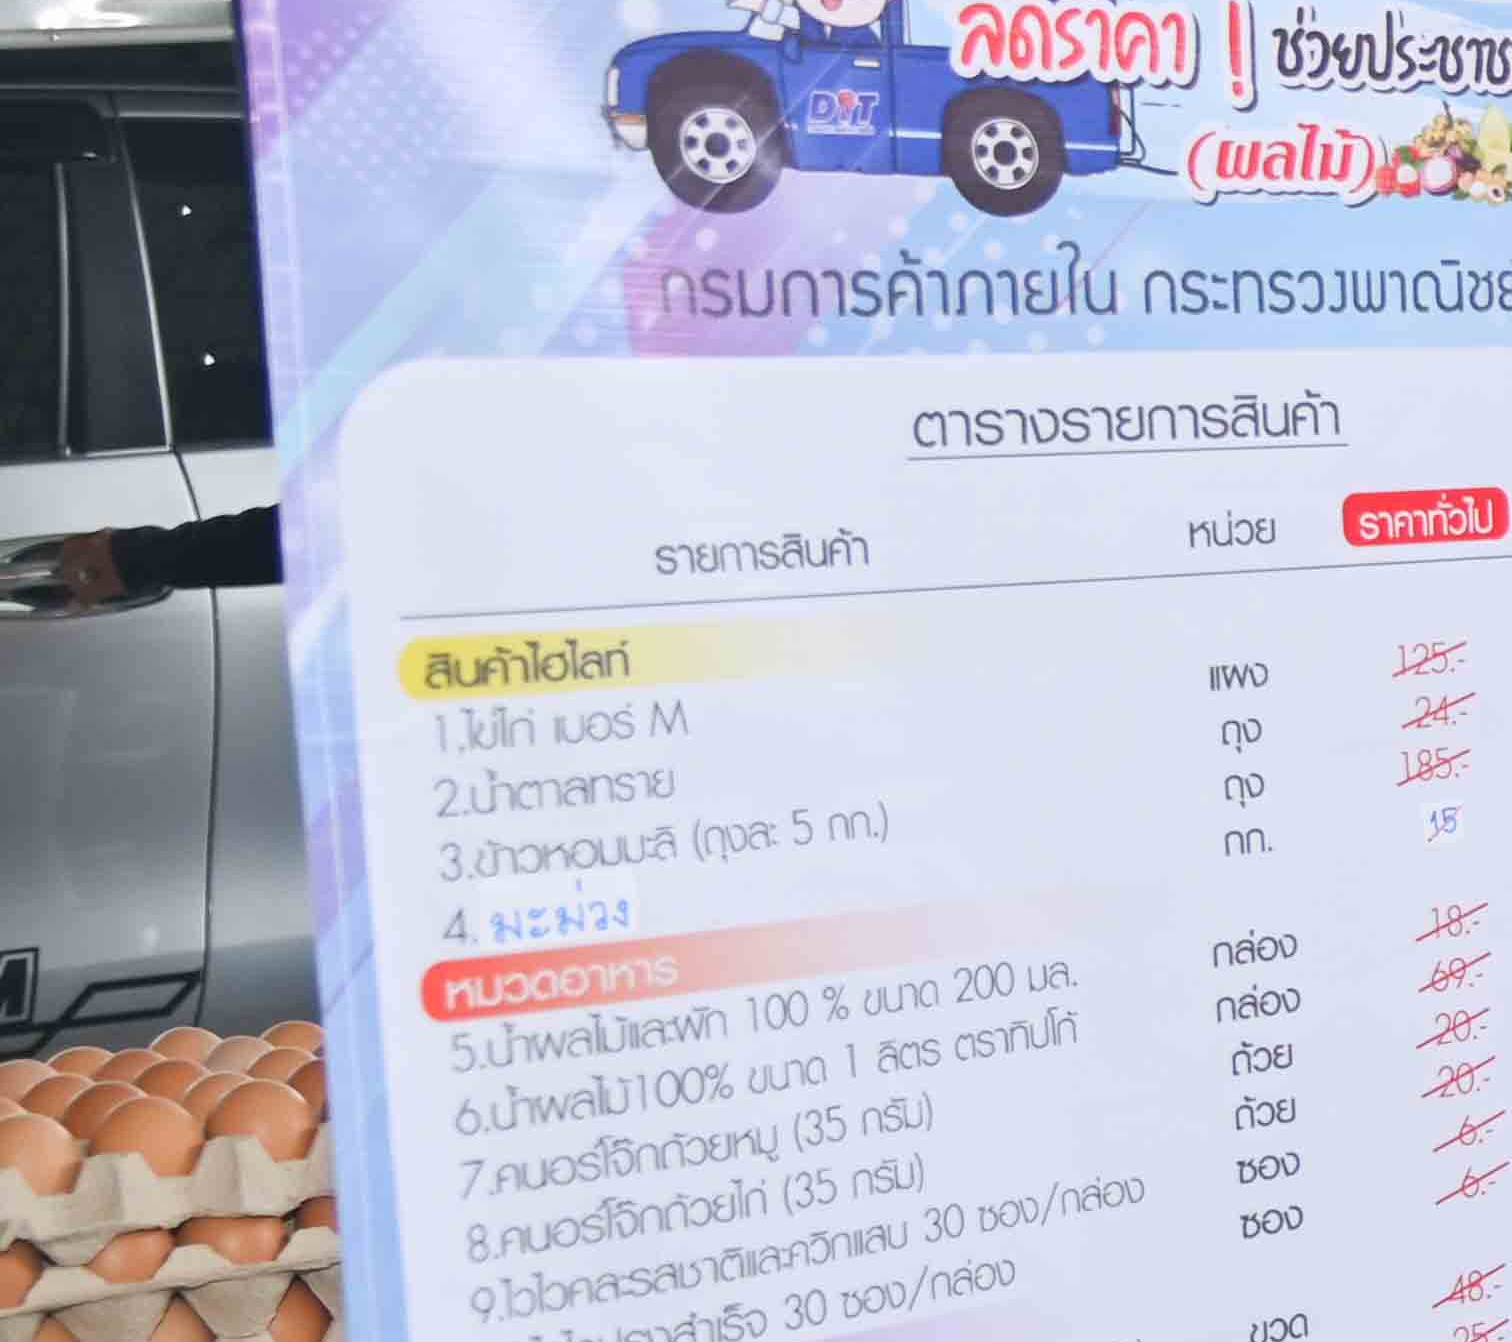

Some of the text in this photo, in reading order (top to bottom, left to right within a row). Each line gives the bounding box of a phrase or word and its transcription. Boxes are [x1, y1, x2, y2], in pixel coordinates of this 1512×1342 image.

[957, 1, 1189, 72] ลดราคา
[1187, 122, 1375, 194] (ผลไม้)
[658, 241, 1119, 320] กรมการค้าภายใน
[912, 389, 1342, 451] ตารางรายการสินค้า
[654, 528, 871, 576] รายการสินค้า
[1187, 512, 1277, 549] หน่วย
[1358, 490, 1495, 540] ราคาทั่วไป
[424, 639, 630, 690] สินค้าไฮไลท์
[1209, 662, 1269, 692] แผง
[650, 700, 689, 738] M
[1220, 718, 1263, 753] ถุง
[433, 767, 677, 818] 2.น้ำตาลทราย
[440, 825, 678, 883] 3.ข้าวหอมมะลิ
[792, 808, 814, 846] 5
[828, 800, 890, 843] กก.)
[1225, 826, 1273, 857] กก.
[1212, 933, 1298, 967] กล่อง
[1231, 1041, 1294, 1075] ถ้วย
[924, 1202, 965, 1246] 30
